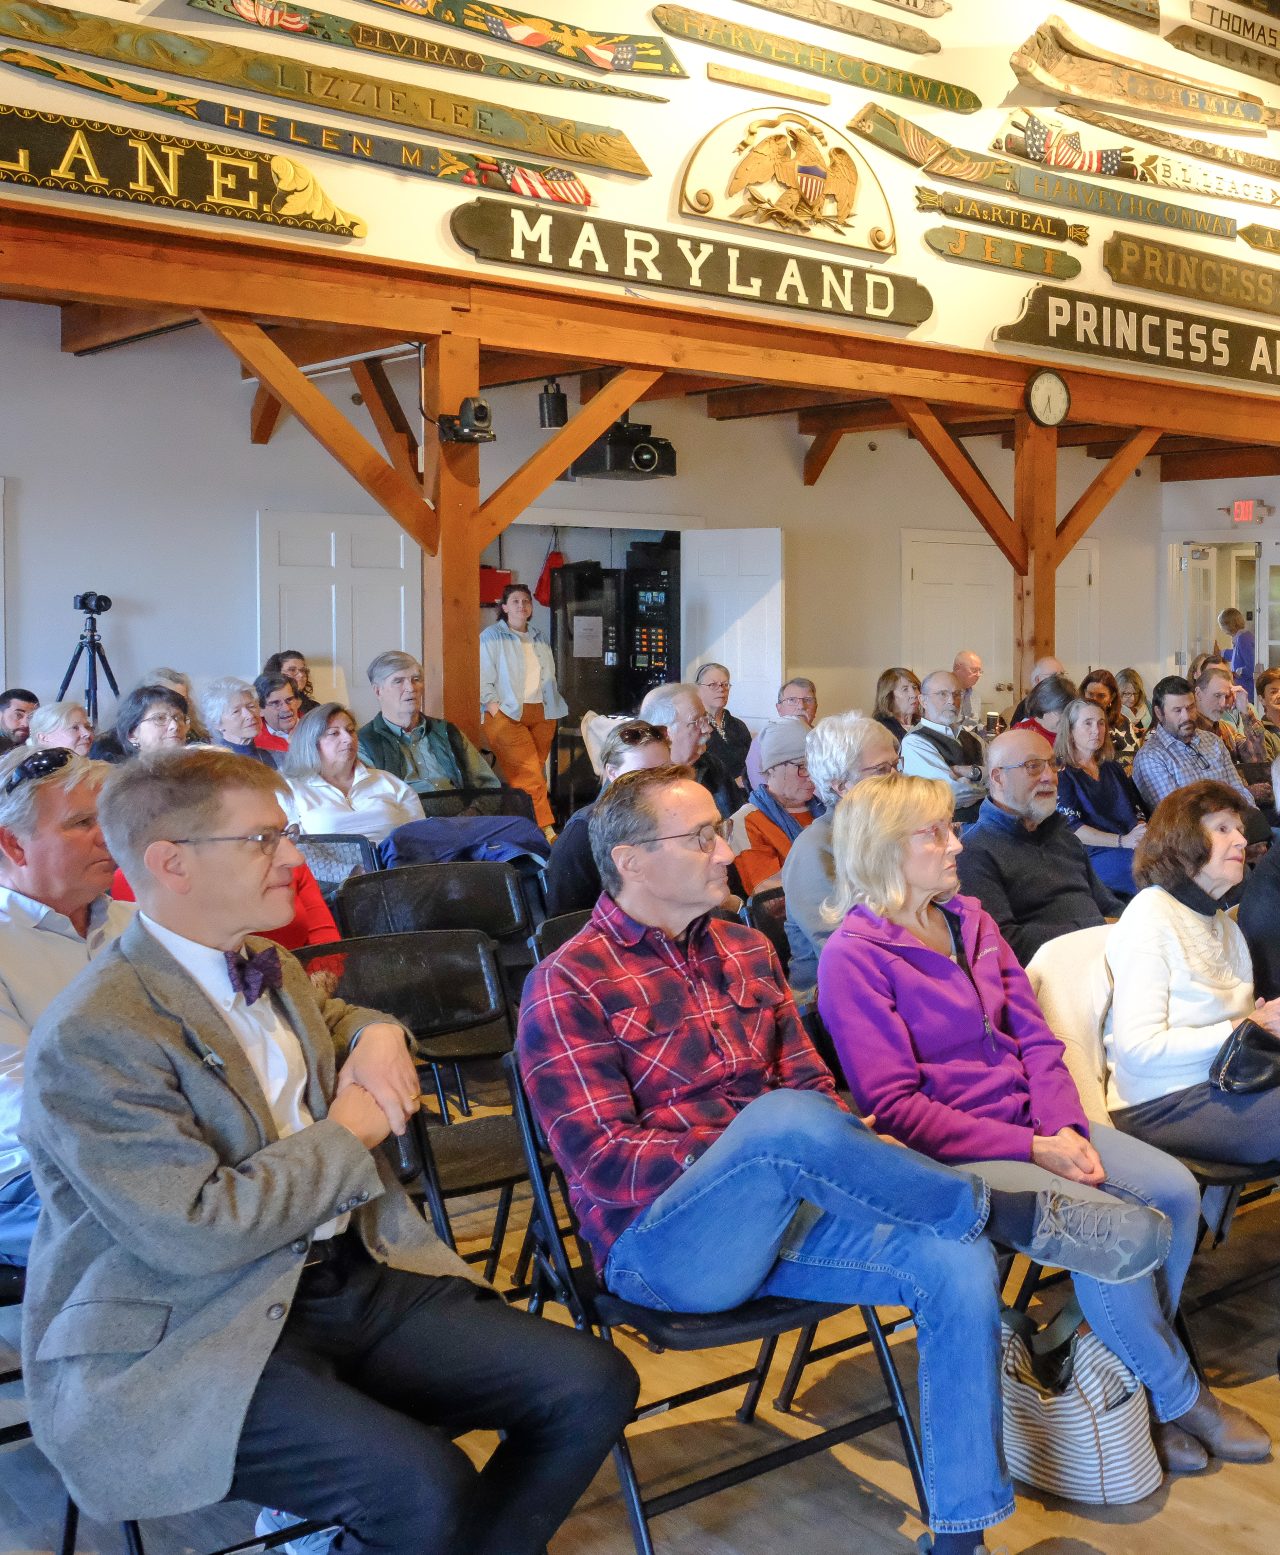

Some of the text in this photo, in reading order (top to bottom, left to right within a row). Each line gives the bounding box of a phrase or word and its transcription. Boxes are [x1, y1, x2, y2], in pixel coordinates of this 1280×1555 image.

[782, 0, 907, 39] ONWAY
[224, 105, 437, 170] HELEN M.
[510, 208, 895, 317] MARYLAND
[948, 229, 1062, 275] JEFF
[1121, 241, 1274, 305] PRINCESS
[1048, 296, 1230, 367] PRINCESS
[1234, 500, 1253, 521] EXIT
